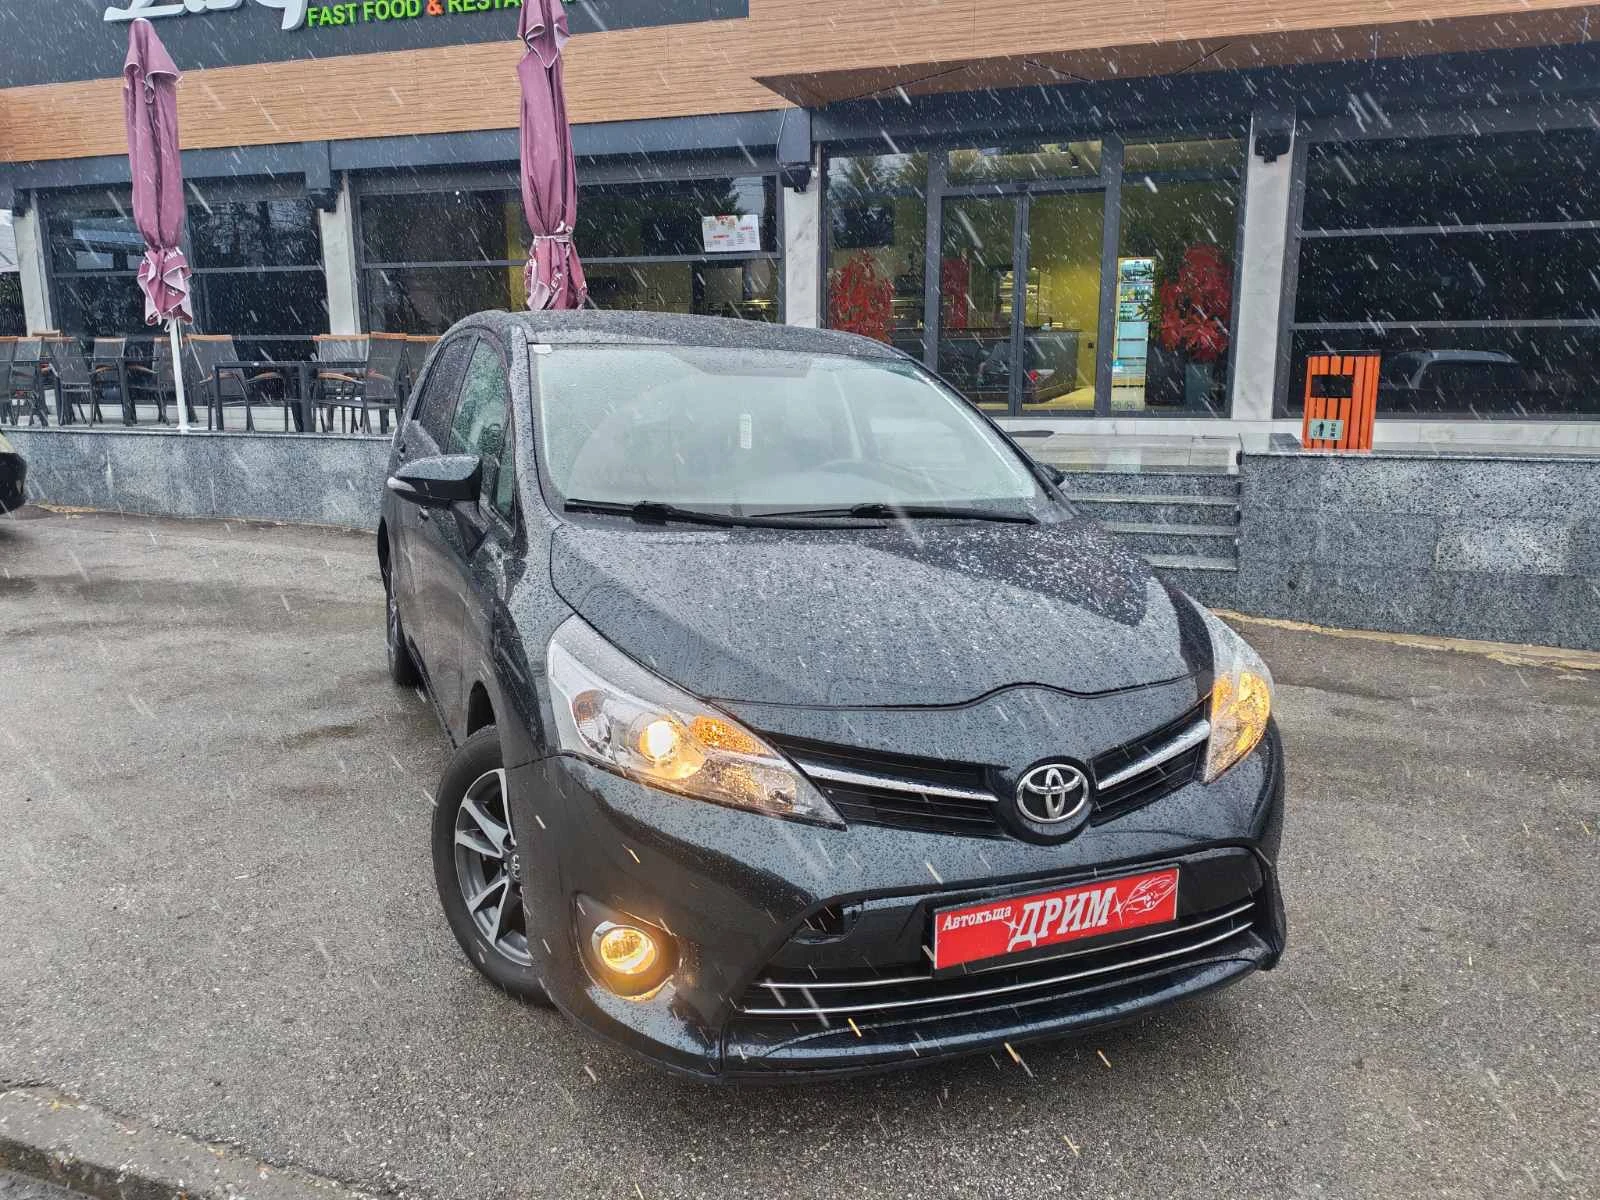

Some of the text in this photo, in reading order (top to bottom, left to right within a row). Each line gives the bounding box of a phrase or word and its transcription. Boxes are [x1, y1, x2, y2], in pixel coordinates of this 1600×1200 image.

[307, 3, 357, 27] FAST
[362, 0, 421, 20] FOOD
[426, 0, 444, 16] &
[942, 886, 1117, 953] Автокъща ДРИМ
